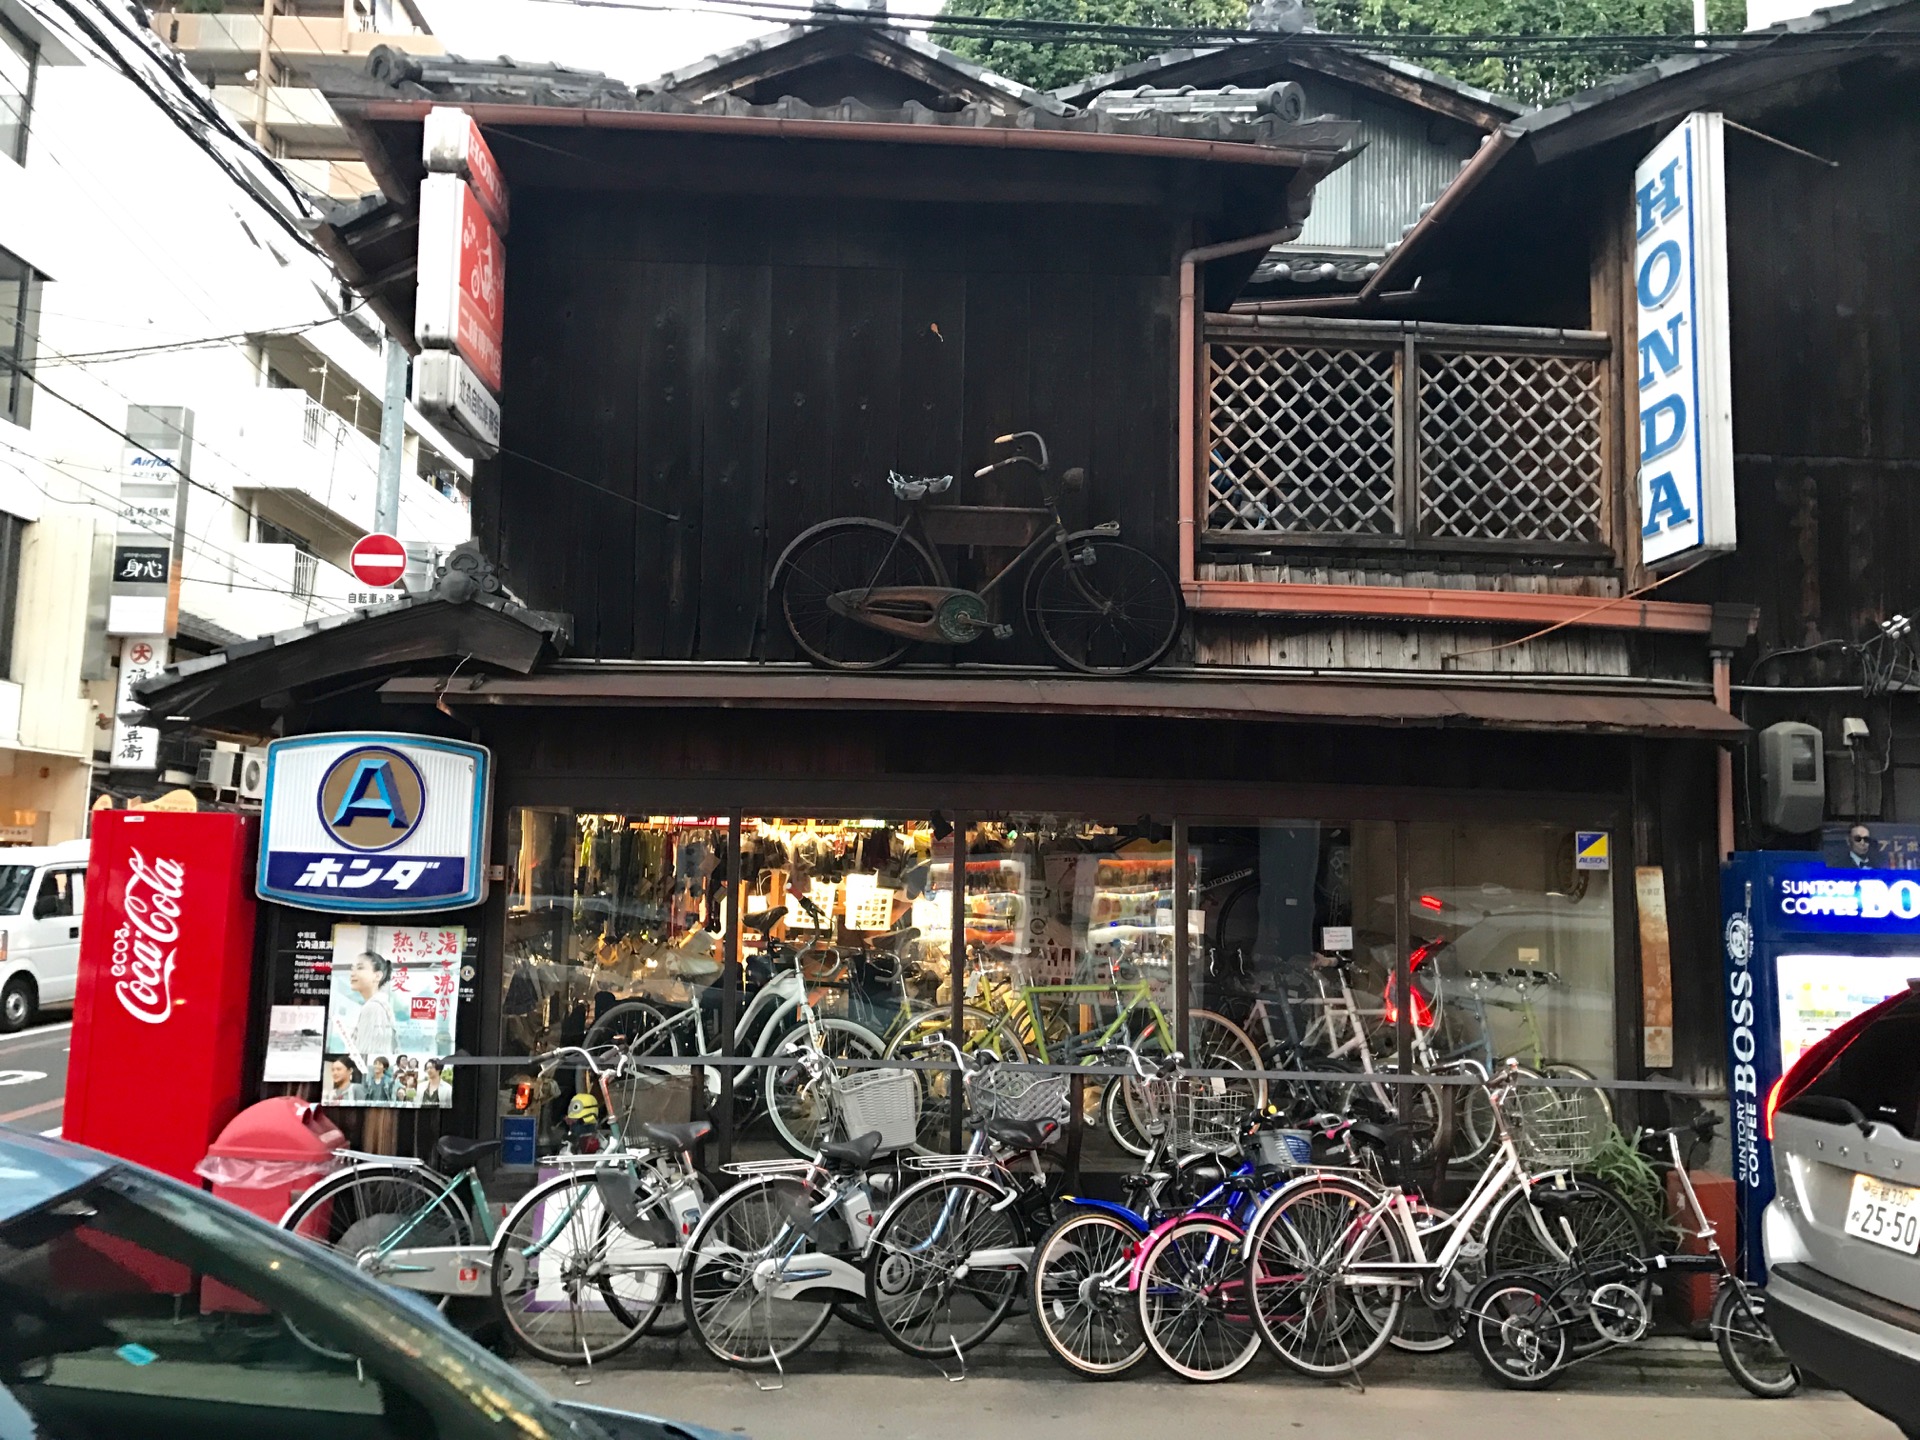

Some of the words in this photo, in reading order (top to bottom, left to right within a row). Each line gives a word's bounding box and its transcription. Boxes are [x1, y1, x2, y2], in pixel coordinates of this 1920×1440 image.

[469, 132, 505, 205] HOND
[1636, 156, 1692, 538] HONDA
[332, 758, 410, 828] A
[294, 858, 440, 891] ホンダ
[1781, 880, 1858, 895] SUNTORY
[1781, 897, 1859, 917] COFFEE
[115, 846, 186, 1024] Coca-Cola
[391, 929, 414, 993] 熱い愛
[411, 999, 436, 1009] 10.29
[434, 931, 460, 1021] 湯を沸かす
[1730, 971, 1757, 1097] BOSS
[1736, 1098, 1747, 1182] SUNTORY
[1746, 1102, 1760, 1188] COFFEE
